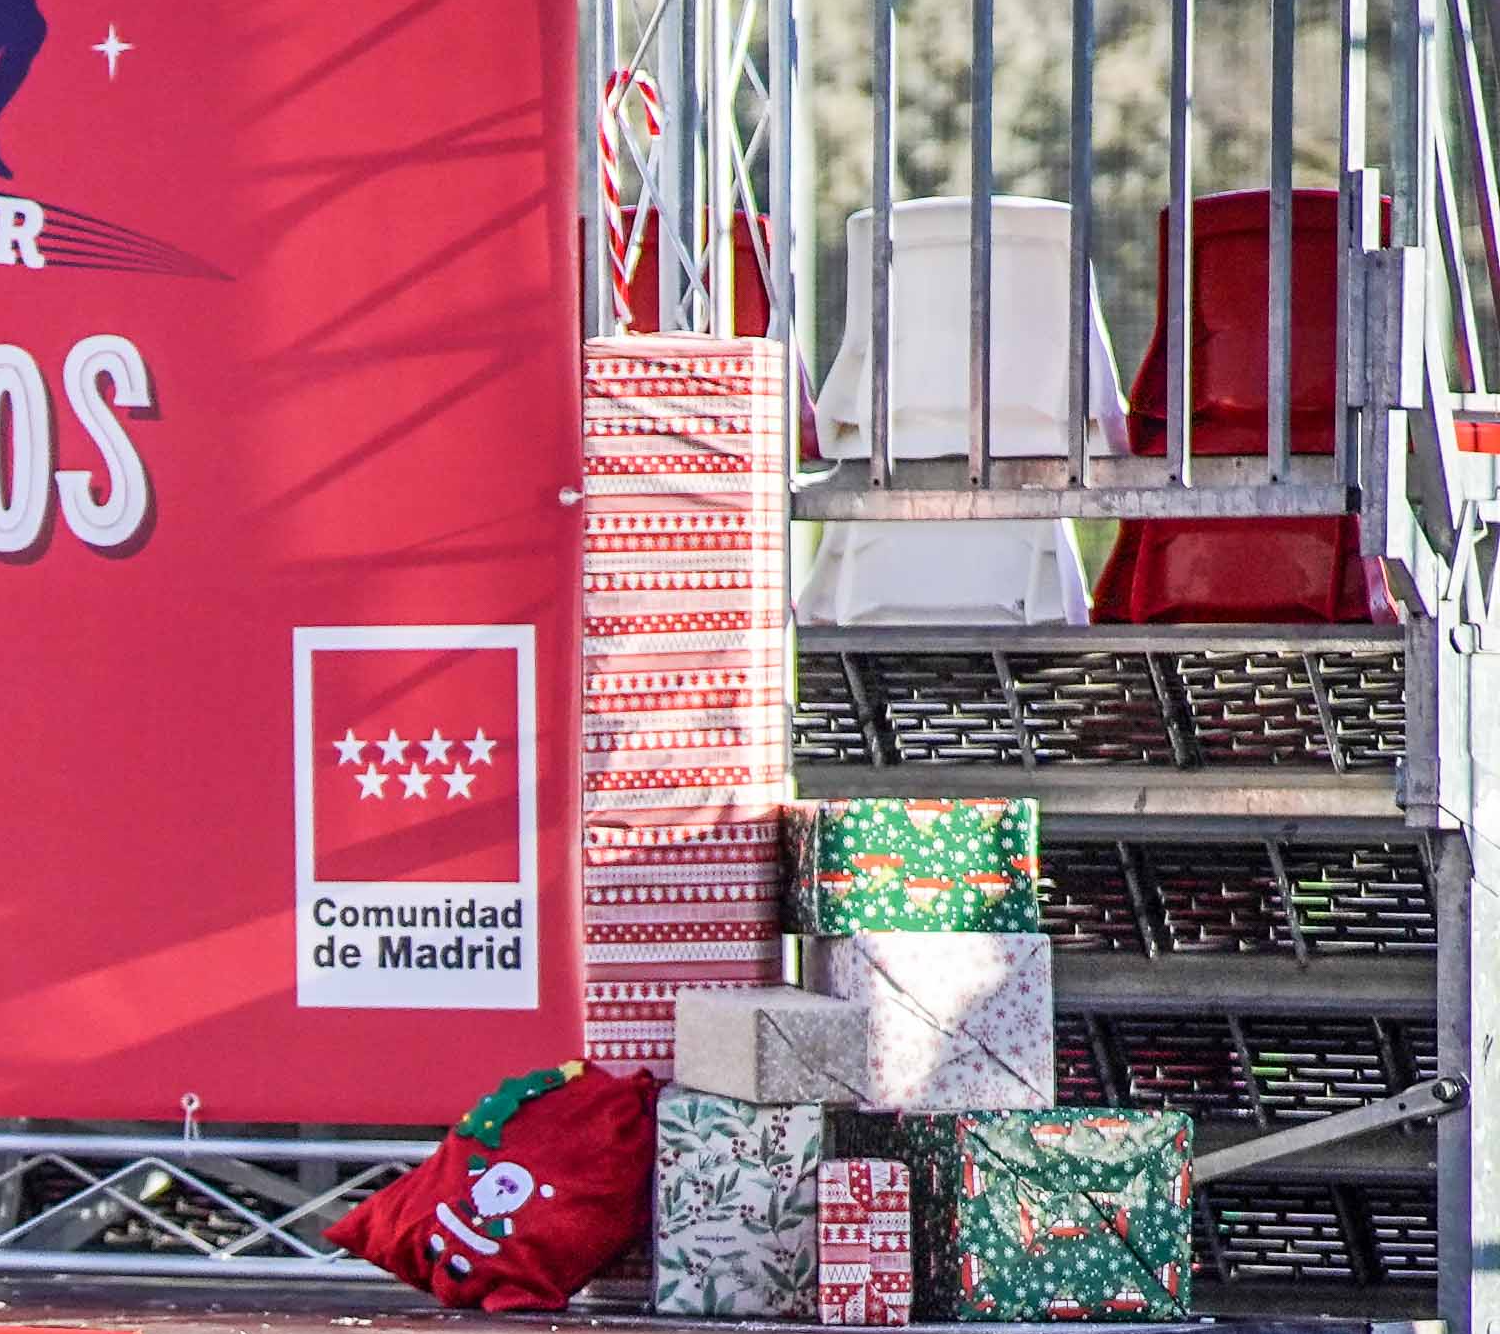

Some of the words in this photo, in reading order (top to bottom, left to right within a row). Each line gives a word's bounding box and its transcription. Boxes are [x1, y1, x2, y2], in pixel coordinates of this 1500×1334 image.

[312, 897, 523, 929] Comunidad
[312, 935, 362, 969] de
[376, 935, 523, 971] Madrid
